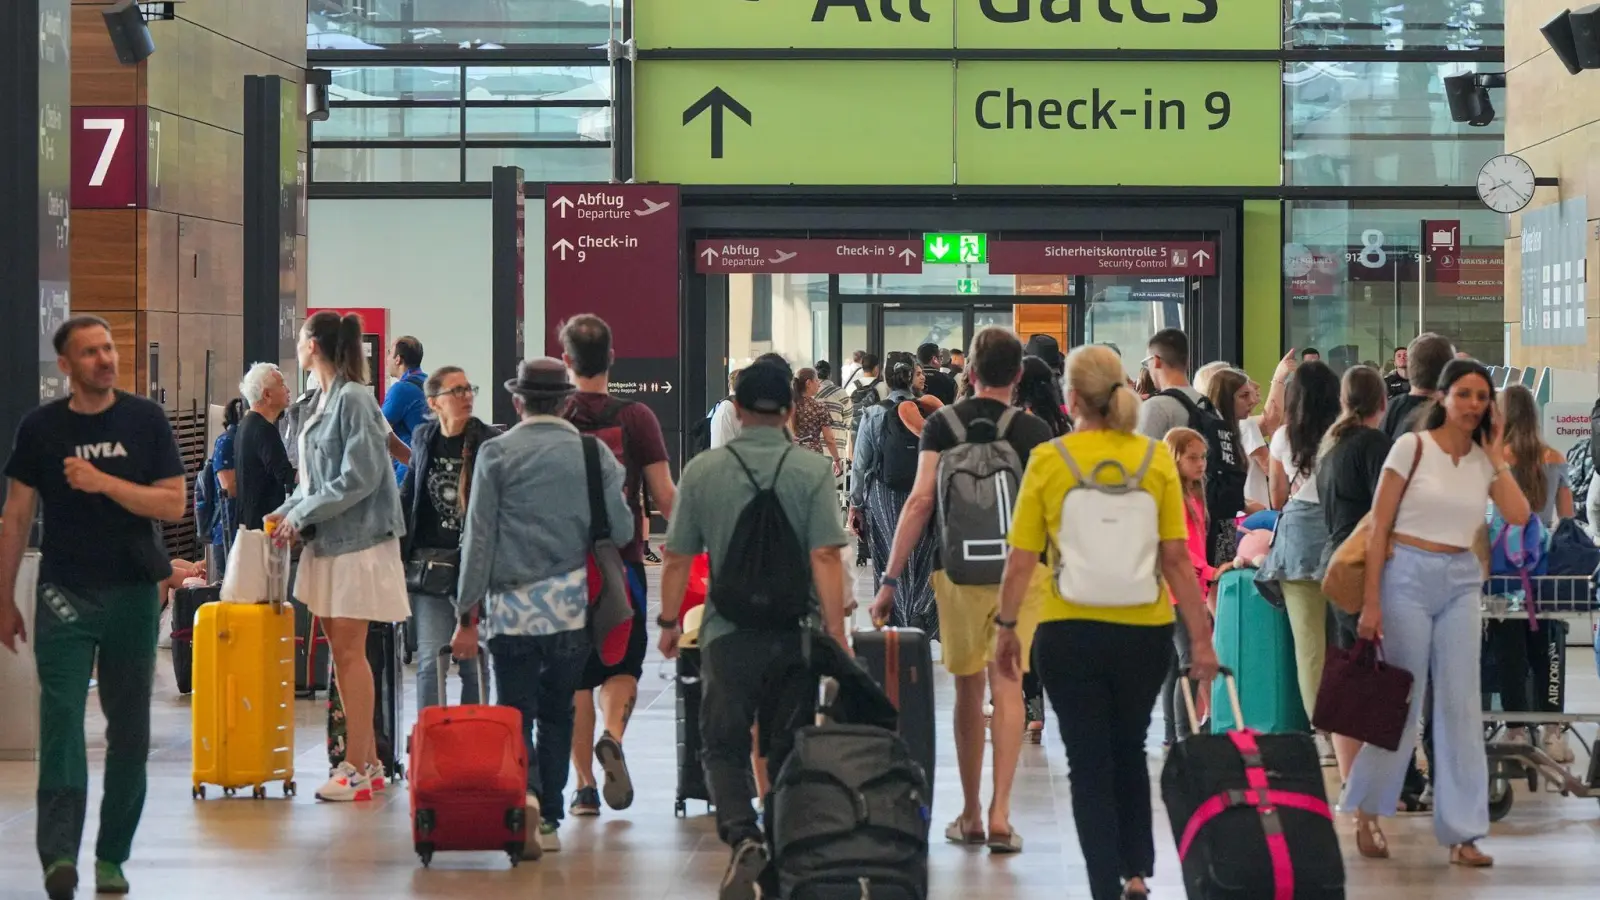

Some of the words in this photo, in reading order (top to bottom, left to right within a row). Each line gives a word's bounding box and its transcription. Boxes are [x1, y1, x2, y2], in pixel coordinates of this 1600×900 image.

[975, 88, 1185, 130] Check-in
[1204, 91, 1231, 130] 9
[84, 118, 125, 186] 7
[577, 193, 624, 208] Abflug
[577, 209, 631, 221] Departure
[578, 235, 638, 248] Check-in
[722, 245, 760, 257] Abflug
[836, 245, 885, 255] Check-in
[888, 246, 895, 255] 9
[1045, 247, 1157, 256] Sicherheitskontrolle
[1160, 248, 1167, 256] 5
[1361, 229, 1387, 268] 8
[577, 251, 586, 262] 9
[722, 258, 765, 267] Departure
[1415, 253, 1432, 262] 95
[1098, 259, 1133, 270] Security
[1135, 259, 1167, 268] Control
[1548, 684, 1560, 706] AIR
